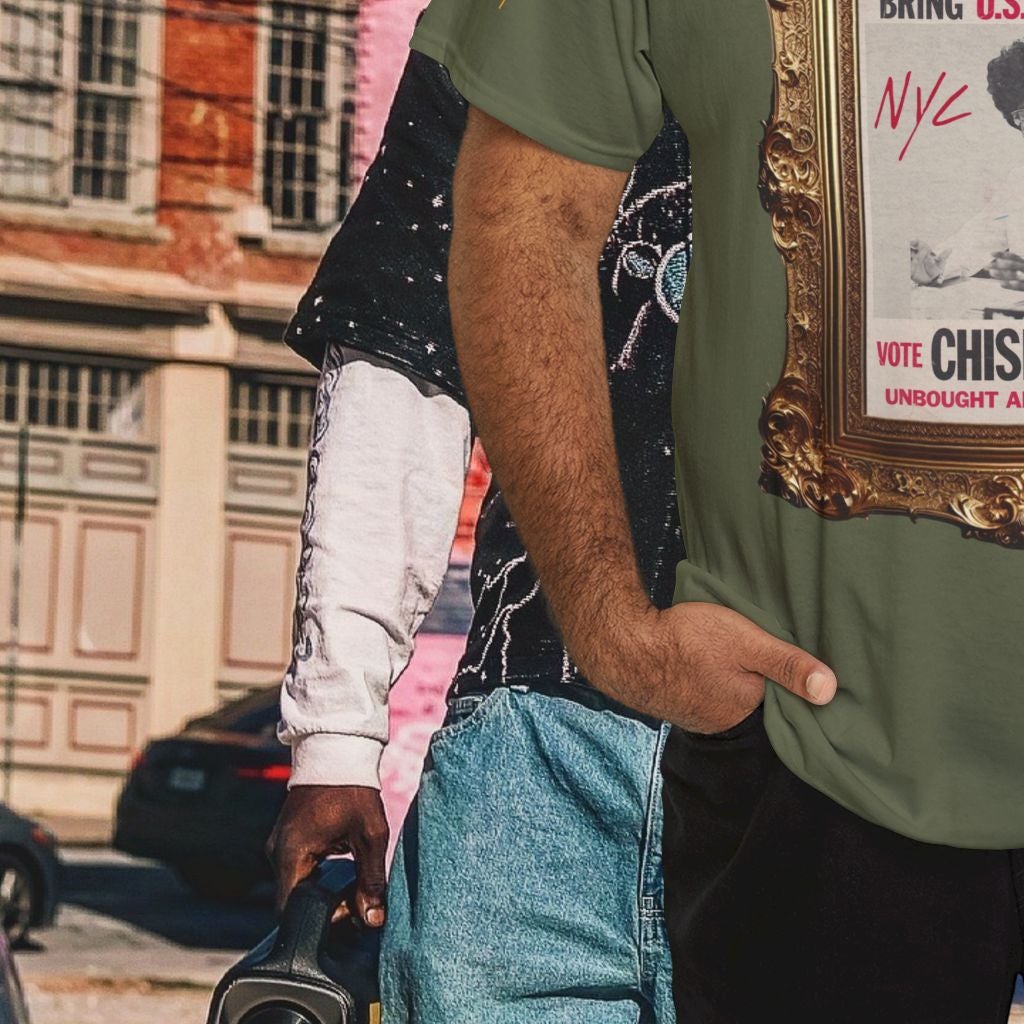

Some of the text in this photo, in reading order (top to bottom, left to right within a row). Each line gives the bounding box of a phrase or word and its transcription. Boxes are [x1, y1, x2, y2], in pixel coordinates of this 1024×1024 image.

[874, 71, 972, 162] NYC
[876, 339, 924, 370] VOTE
[885, 387, 998, 410] UNBOUGHT
